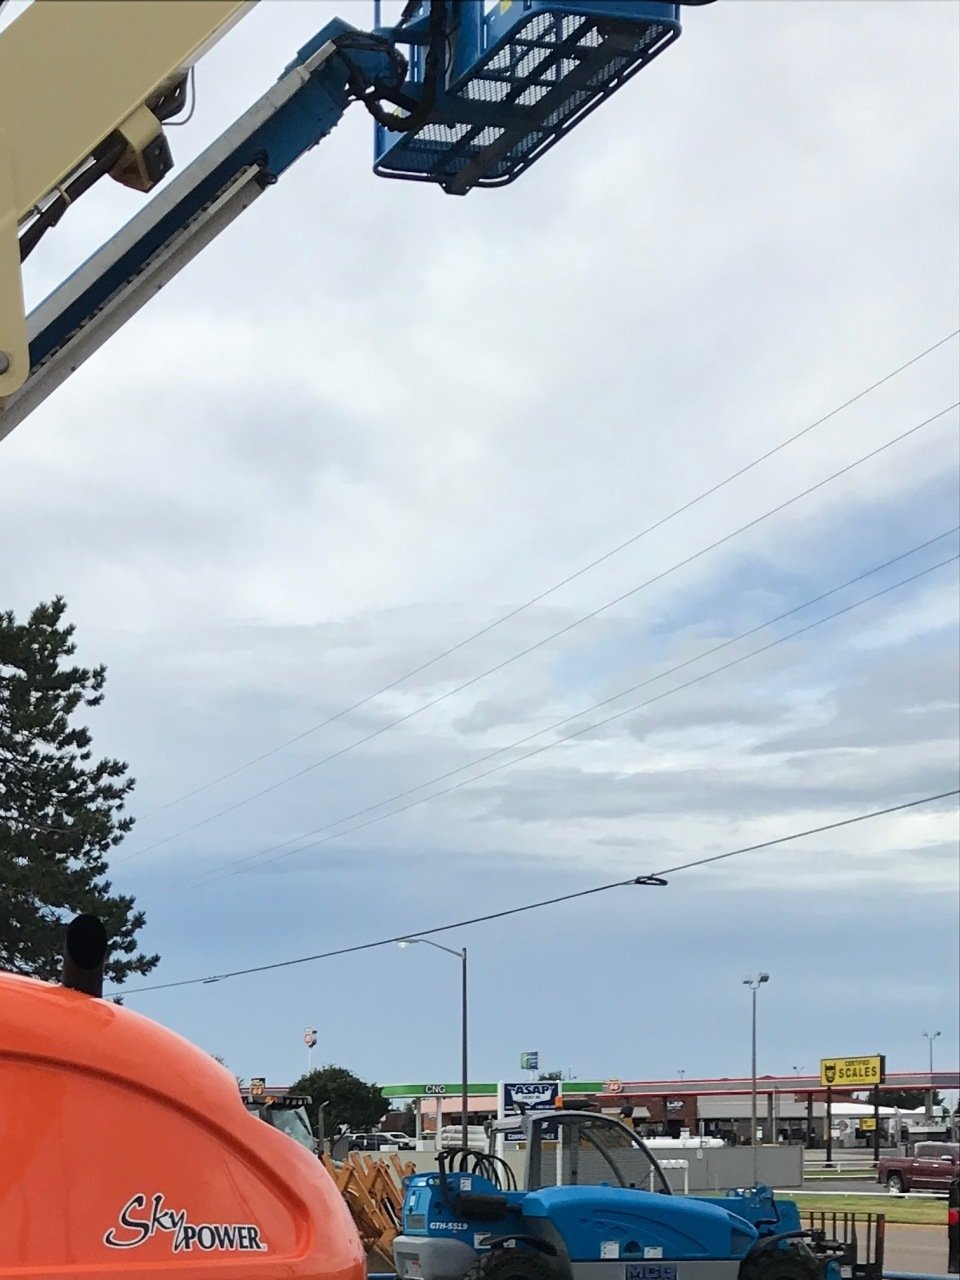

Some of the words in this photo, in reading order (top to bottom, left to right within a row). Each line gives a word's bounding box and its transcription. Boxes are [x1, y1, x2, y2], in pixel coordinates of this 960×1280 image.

[838, 1066, 877, 1078] SCALES
[425, 1086, 446, 1094] CNG
[515, 1085, 549, 1094] ASAP
[429, 1222, 468, 1230] GTH-5519
